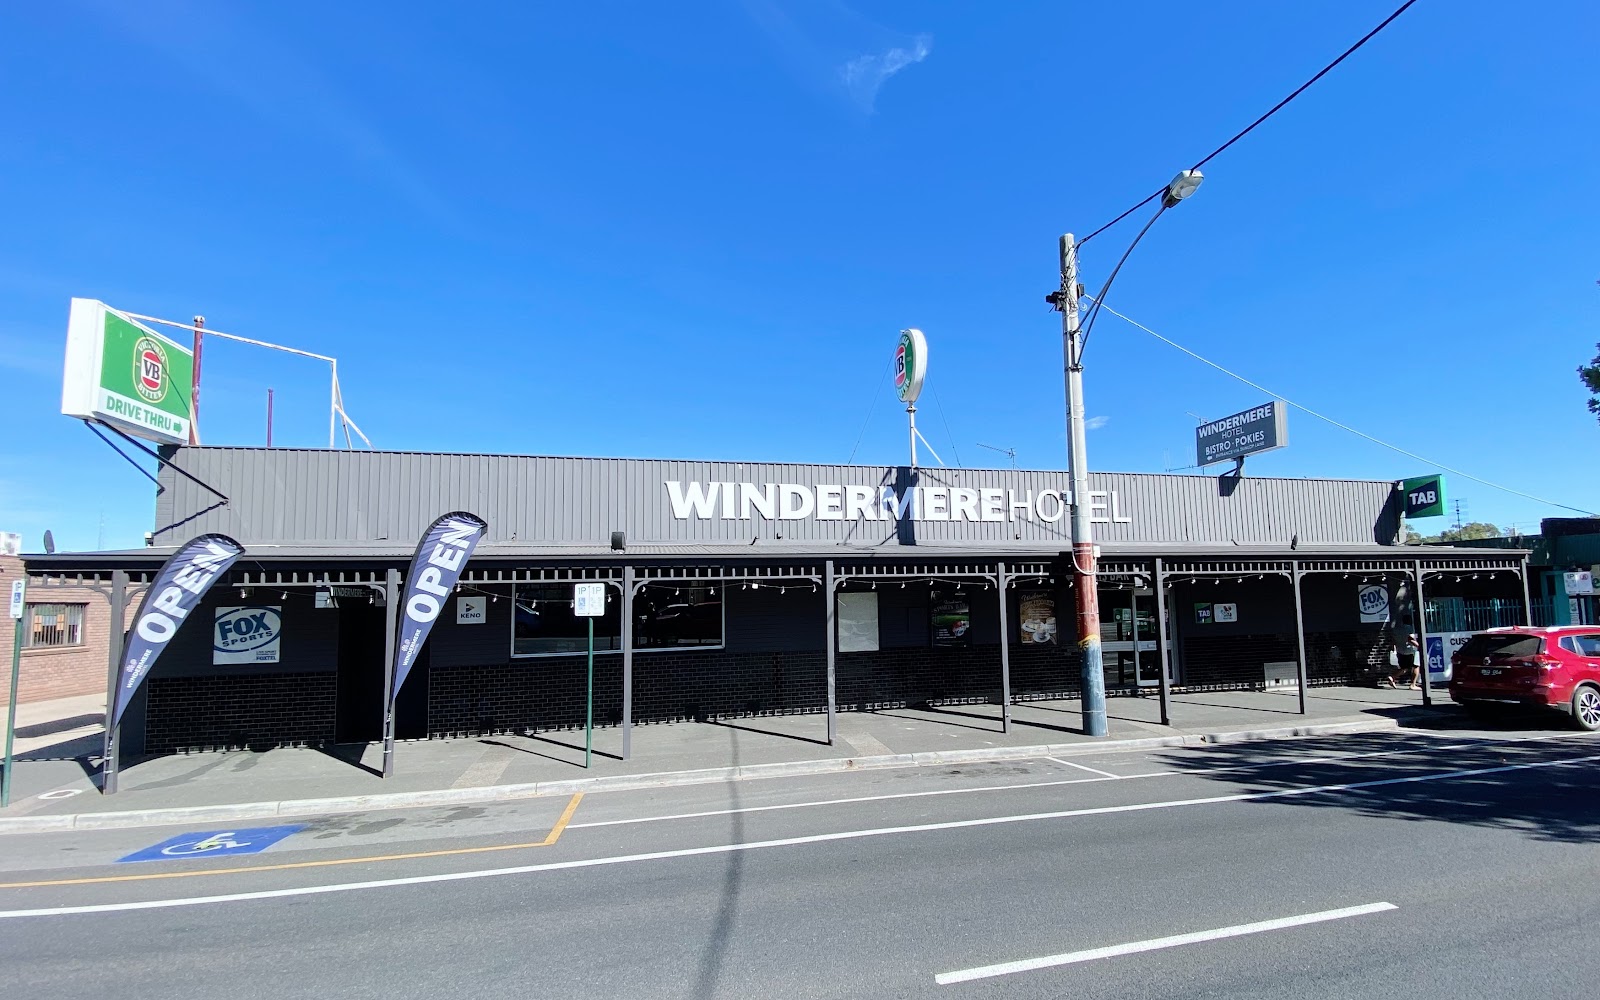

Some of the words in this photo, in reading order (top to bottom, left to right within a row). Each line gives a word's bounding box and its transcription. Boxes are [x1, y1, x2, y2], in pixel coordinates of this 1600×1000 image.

[143, 359, 160, 380] VB
[138, 382, 162, 399] BITTER
[106, 395, 142, 421] DRIVE
[143, 409, 172, 431] THRU
[1198, 405, 1273, 438] WINDERMERE
[1205, 440, 1231, 456] BISTRO
[1235, 430, 1265, 447] POKIES
[1221, 427, 1245, 440] HOTEL
[1008, 488, 1132, 523] HOEL
[1409, 490, 1437, 506] TAB
[406, 520, 480, 623] OPEN
[138, 542, 236, 643] OPEN
[578, 586, 587, 595] 1P
[592, 586, 602, 595] 1P
[1360, 588, 1385, 607] FOX
[1197, 610, 1211, 618] TAB
[1363, 600, 1386, 611] SPORTS
[218, 612, 271, 641] FOX
[222, 630, 273, 648] SPORTS
[402, 629, 422, 666] WINDERMERE
[126, 648, 153, 689] WINDERMERE
